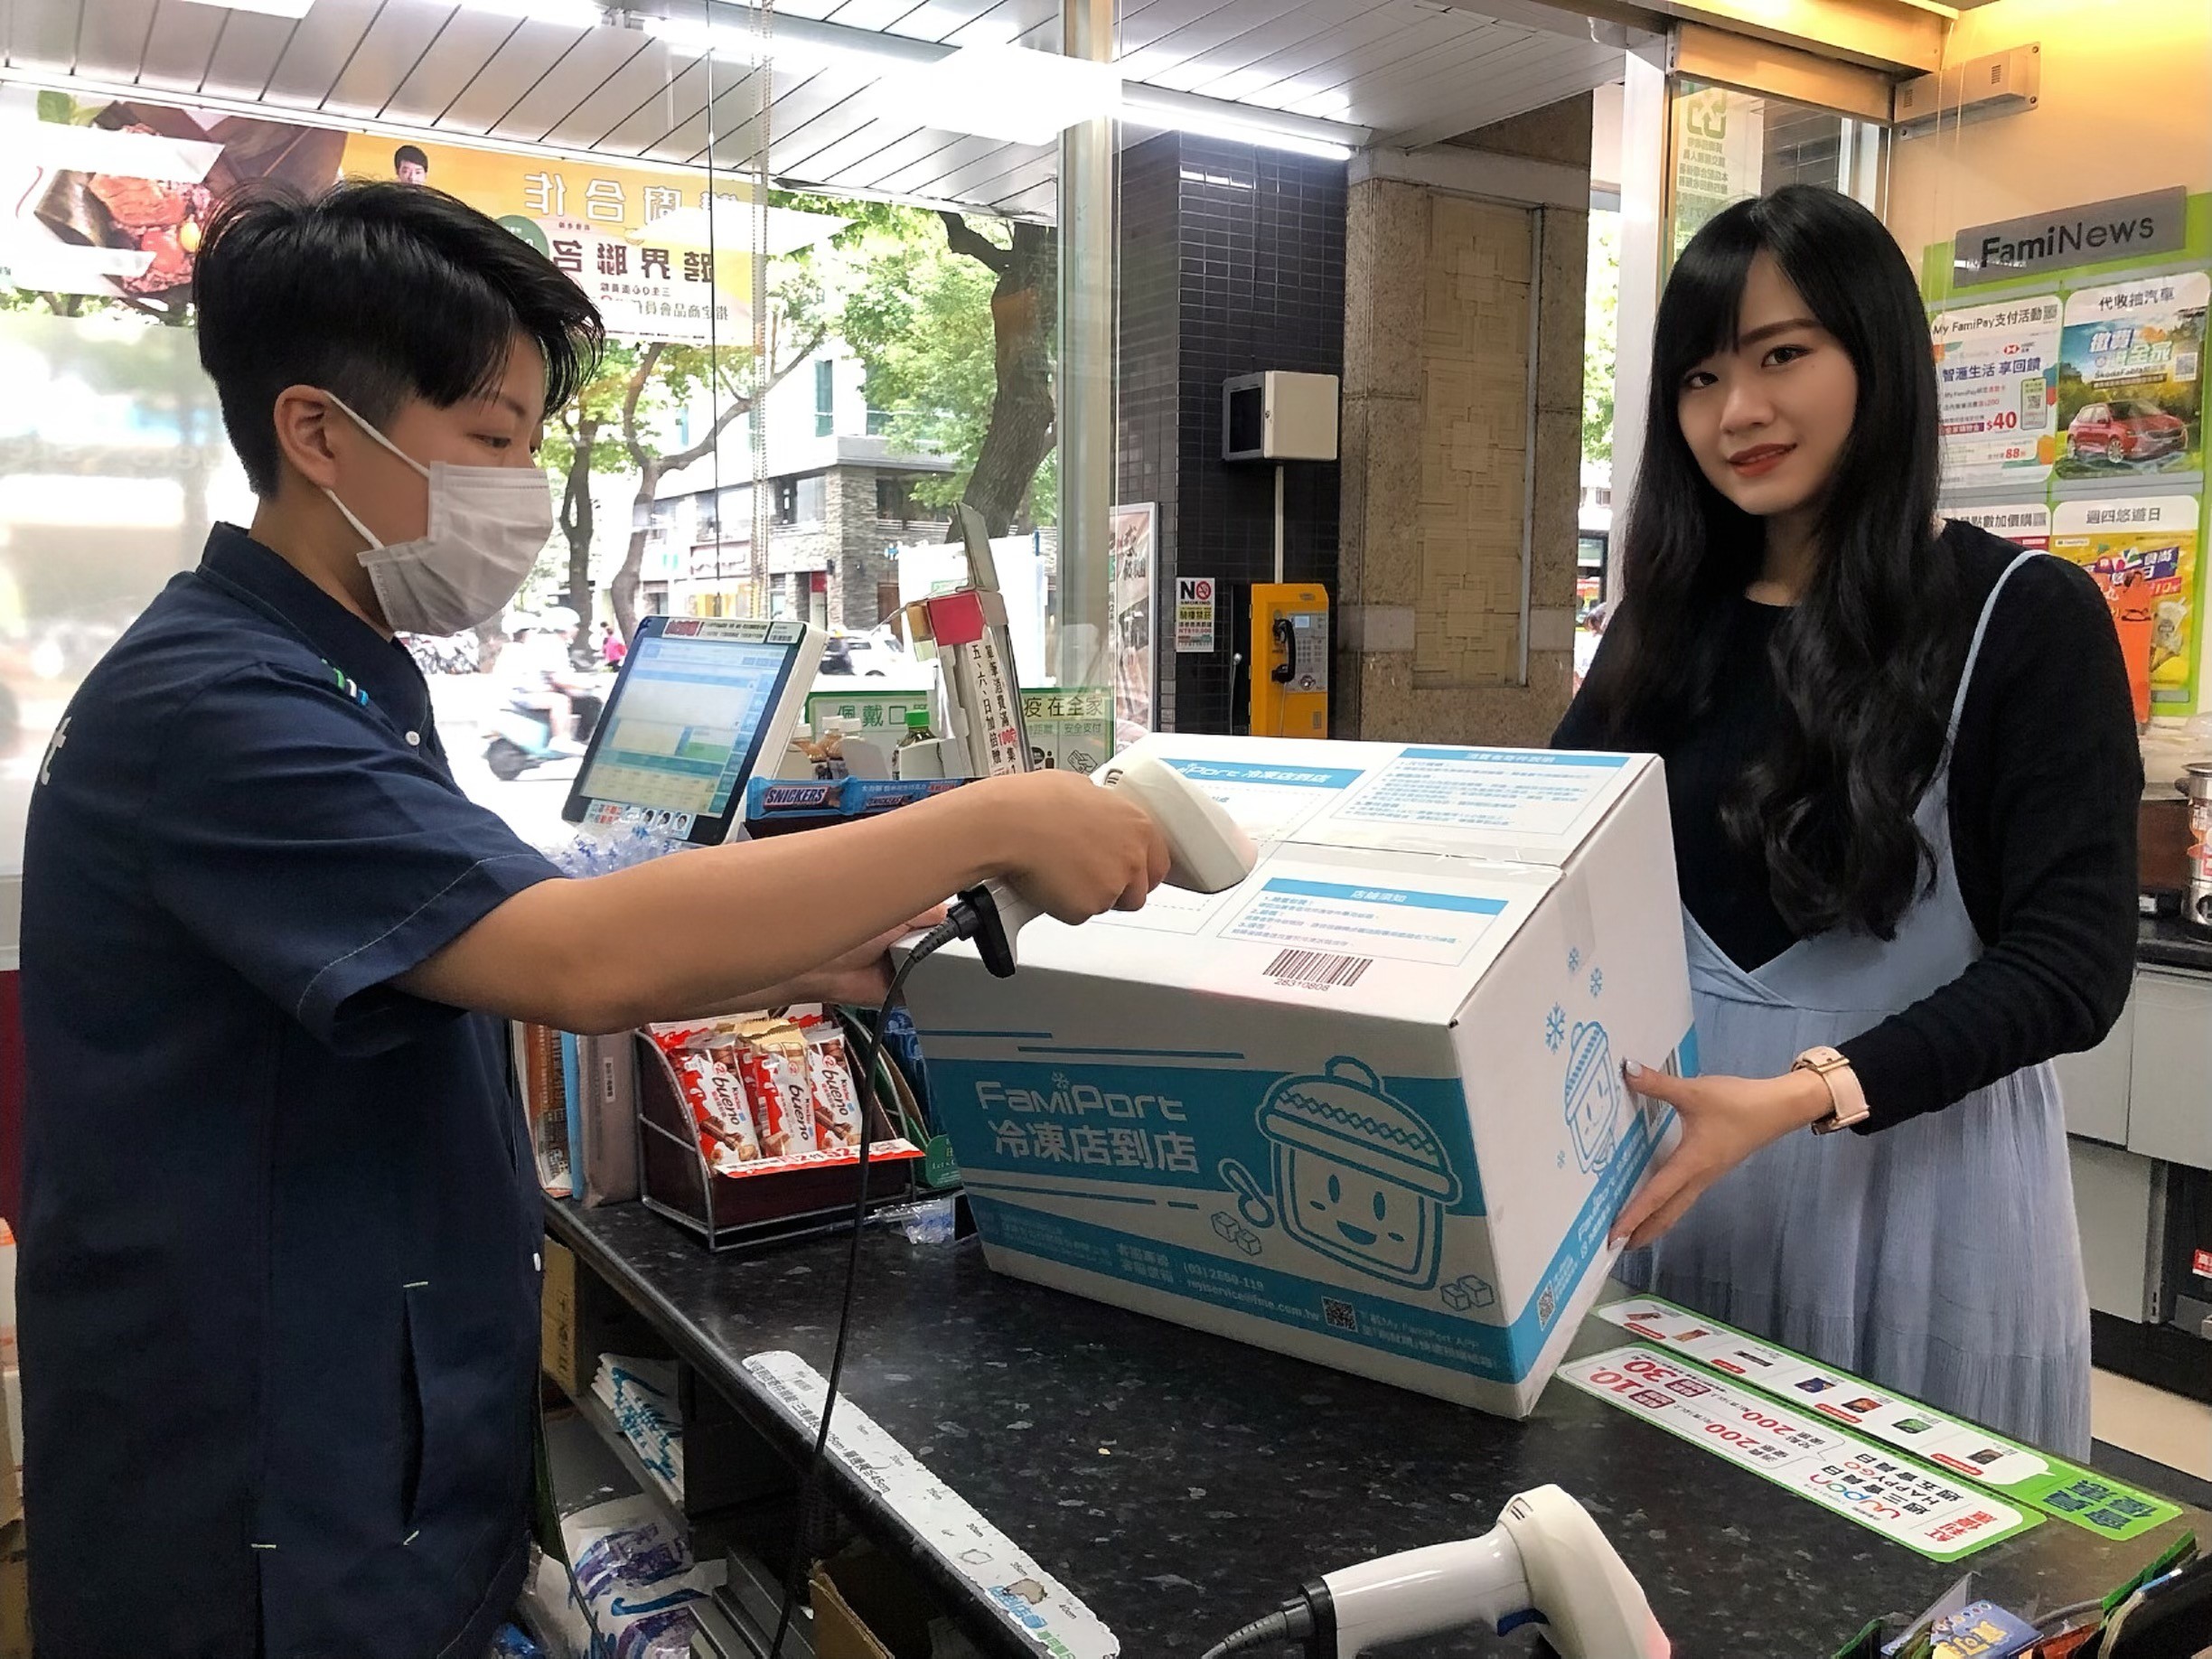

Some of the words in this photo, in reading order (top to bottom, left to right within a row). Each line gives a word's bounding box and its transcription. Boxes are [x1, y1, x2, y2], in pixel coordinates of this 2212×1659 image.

[1982, 216, 2155, 268] FamiNews
[1933, 324, 1950, 335] My
[1986, 410, 2017, 430] $40
[2086, 507, 2161, 525] 週四悠遊日
[766, 787, 824, 804] SNICKERS
[712, 1075, 741, 1126] bueno
[821, 1069, 849, 1116] bueno
[976, 1079, 1187, 1122] FamiPort
[789, 1083, 810, 1141] bueno
[988, 1119, 1200, 1174] 冷凍店到店
[1589, 1370, 1645, 1393] 10
[1624, 1360, 1678, 1383] 30
[1704, 1423, 1761, 1449] 200
[1741, 1411, 1797, 1436] 200
[1821, 1465, 1931, 1515] 週三會員日
[1843, 1461, 1940, 1506] HAPPYGO
[1855, 1453, 1964, 1502] 週五會員日
[1058, 1604, 1077, 1619] 40cm
